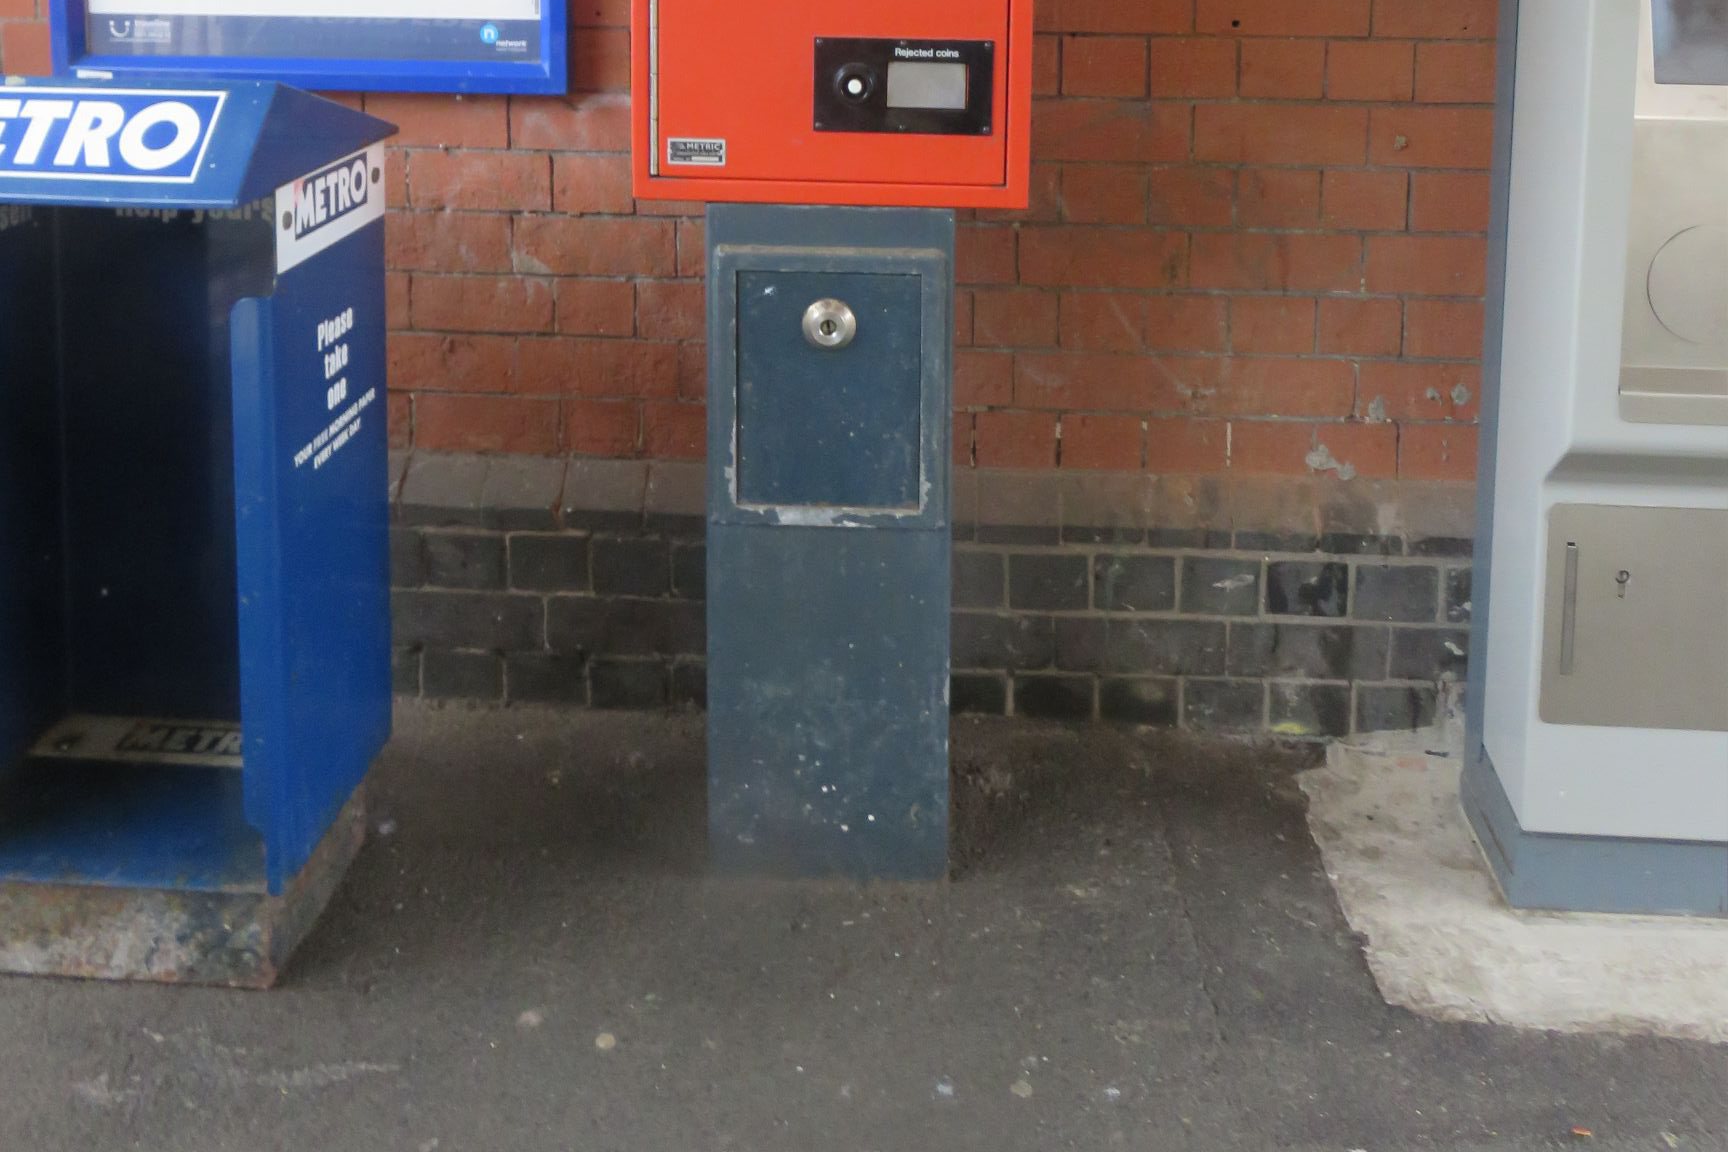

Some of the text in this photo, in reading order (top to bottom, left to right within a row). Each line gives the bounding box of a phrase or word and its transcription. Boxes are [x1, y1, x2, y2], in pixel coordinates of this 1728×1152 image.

[894, 47, 960, 58] Rejected coins
[295, 159, 367, 235] METRO
[317, 307, 353, 352] Please
[324, 343, 349, 380] take
[327, 377, 347, 410] one
[294, 442, 313, 468] YOUR
